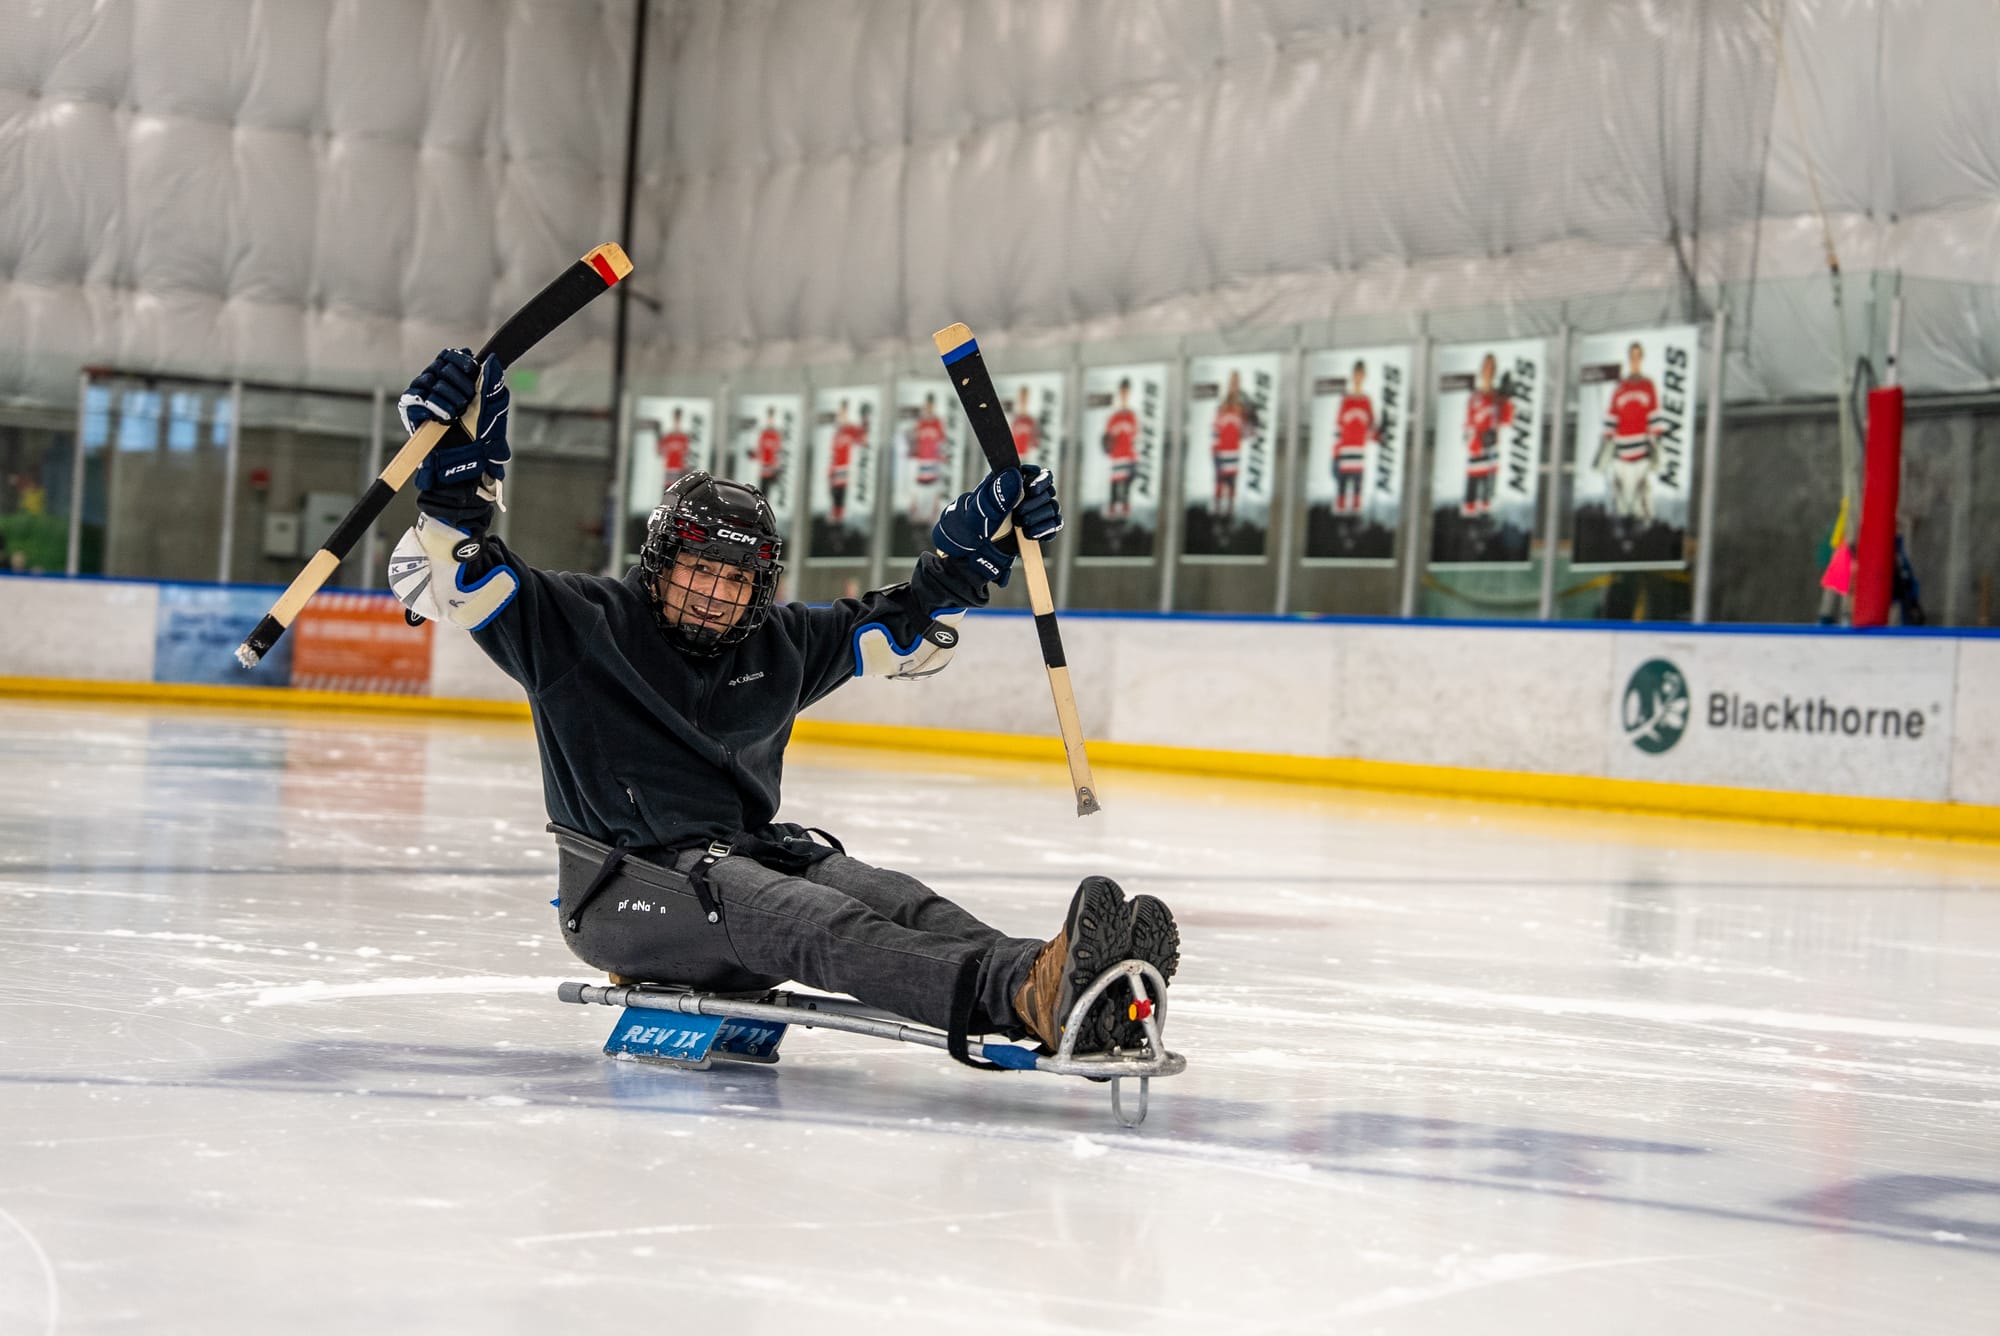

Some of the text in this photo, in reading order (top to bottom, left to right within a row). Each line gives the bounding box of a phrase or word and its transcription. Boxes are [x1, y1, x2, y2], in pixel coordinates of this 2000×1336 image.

[1508, 357, 1536, 494] MINERS
[1660, 346, 1689, 488] MINERS
[444, 461, 478, 477] CCM
[716, 528, 758, 545] CCM
[976, 557, 1000, 576] CCM
[1707, 692, 1925, 739] Blackthorne
[621, 1025, 677, 1046] REV
[716, 1024, 747, 1041] EV
